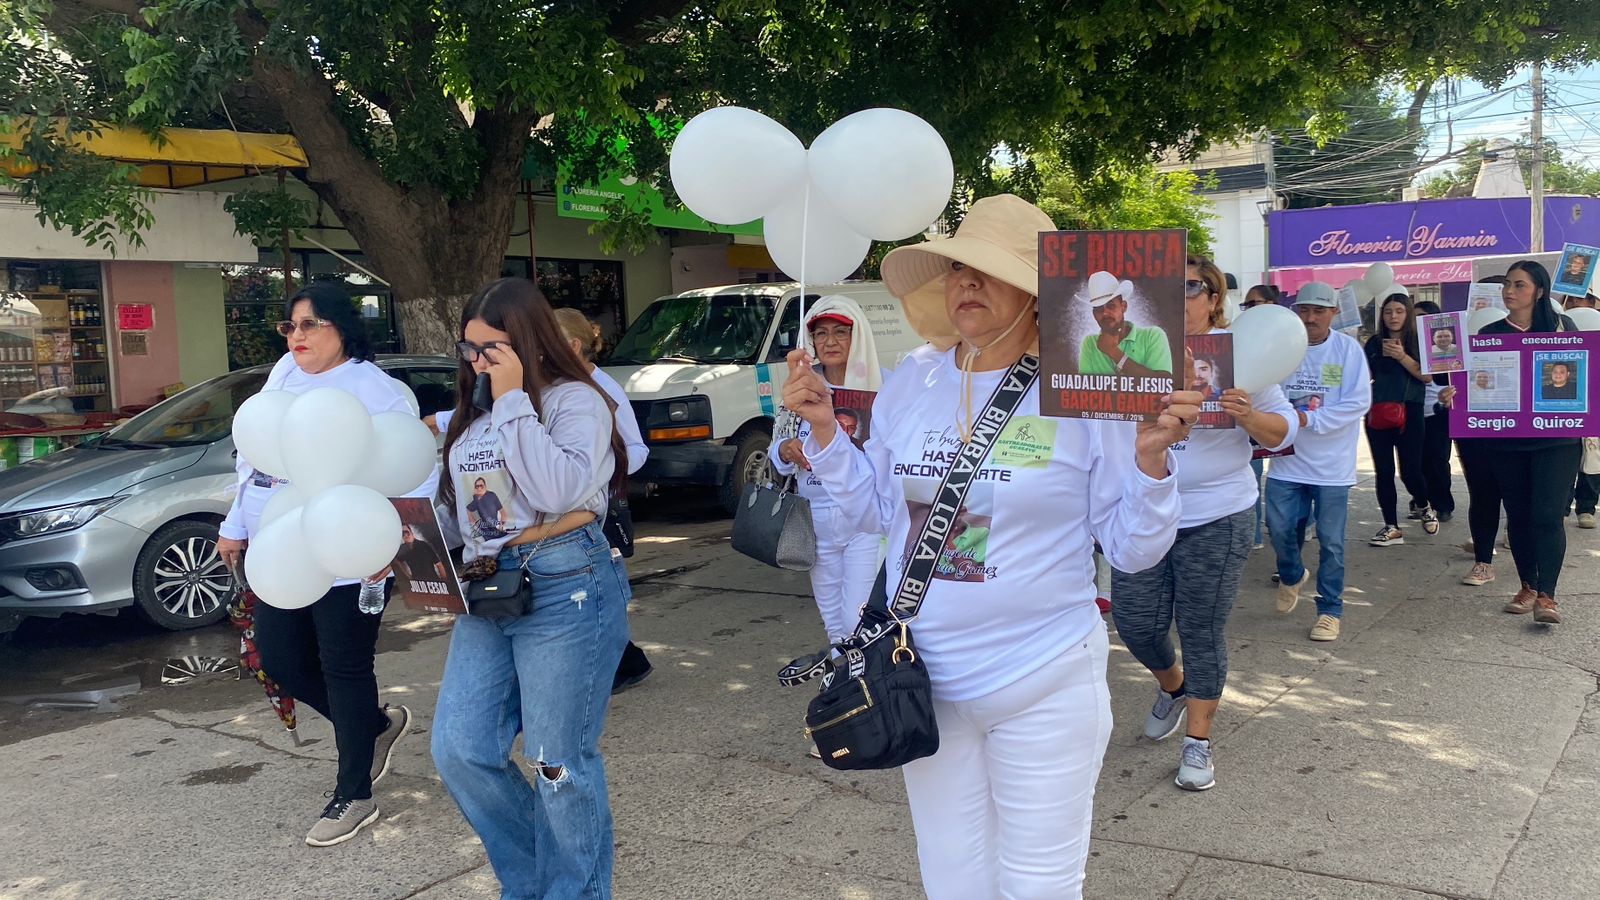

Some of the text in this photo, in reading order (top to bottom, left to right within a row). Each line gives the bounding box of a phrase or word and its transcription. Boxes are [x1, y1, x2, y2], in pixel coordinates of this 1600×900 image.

[571, 186, 600, 197] LORERIA
[1308, 222, 1498, 256] Floreria Yazmin
[1043, 232, 1184, 279] SE BUSCA
[1472, 336, 1583, 347] hasta encontrarte
[1551, 352, 1584, 360] BUSCA!
[1001, 354, 1040, 392] OLA
[759, 384, 772, 396] 02
[1051, 373, 1173, 394] GUADALUPE DE JESUS
[1060, 390, 1112, 411] GARCIA
[1094, 412, 1124, 420] DICIEMBRE
[1467, 416, 1584, 431] Sergio Quiroz
[952, 405, 1009, 474] BIMBA
[468, 449, 494, 462] HASTA
[922, 450, 957, 463] HAS
[946, 481, 967, 499] Y
[915, 502, 956, 560] LOLA
[427, 581, 450, 595] CESAR
